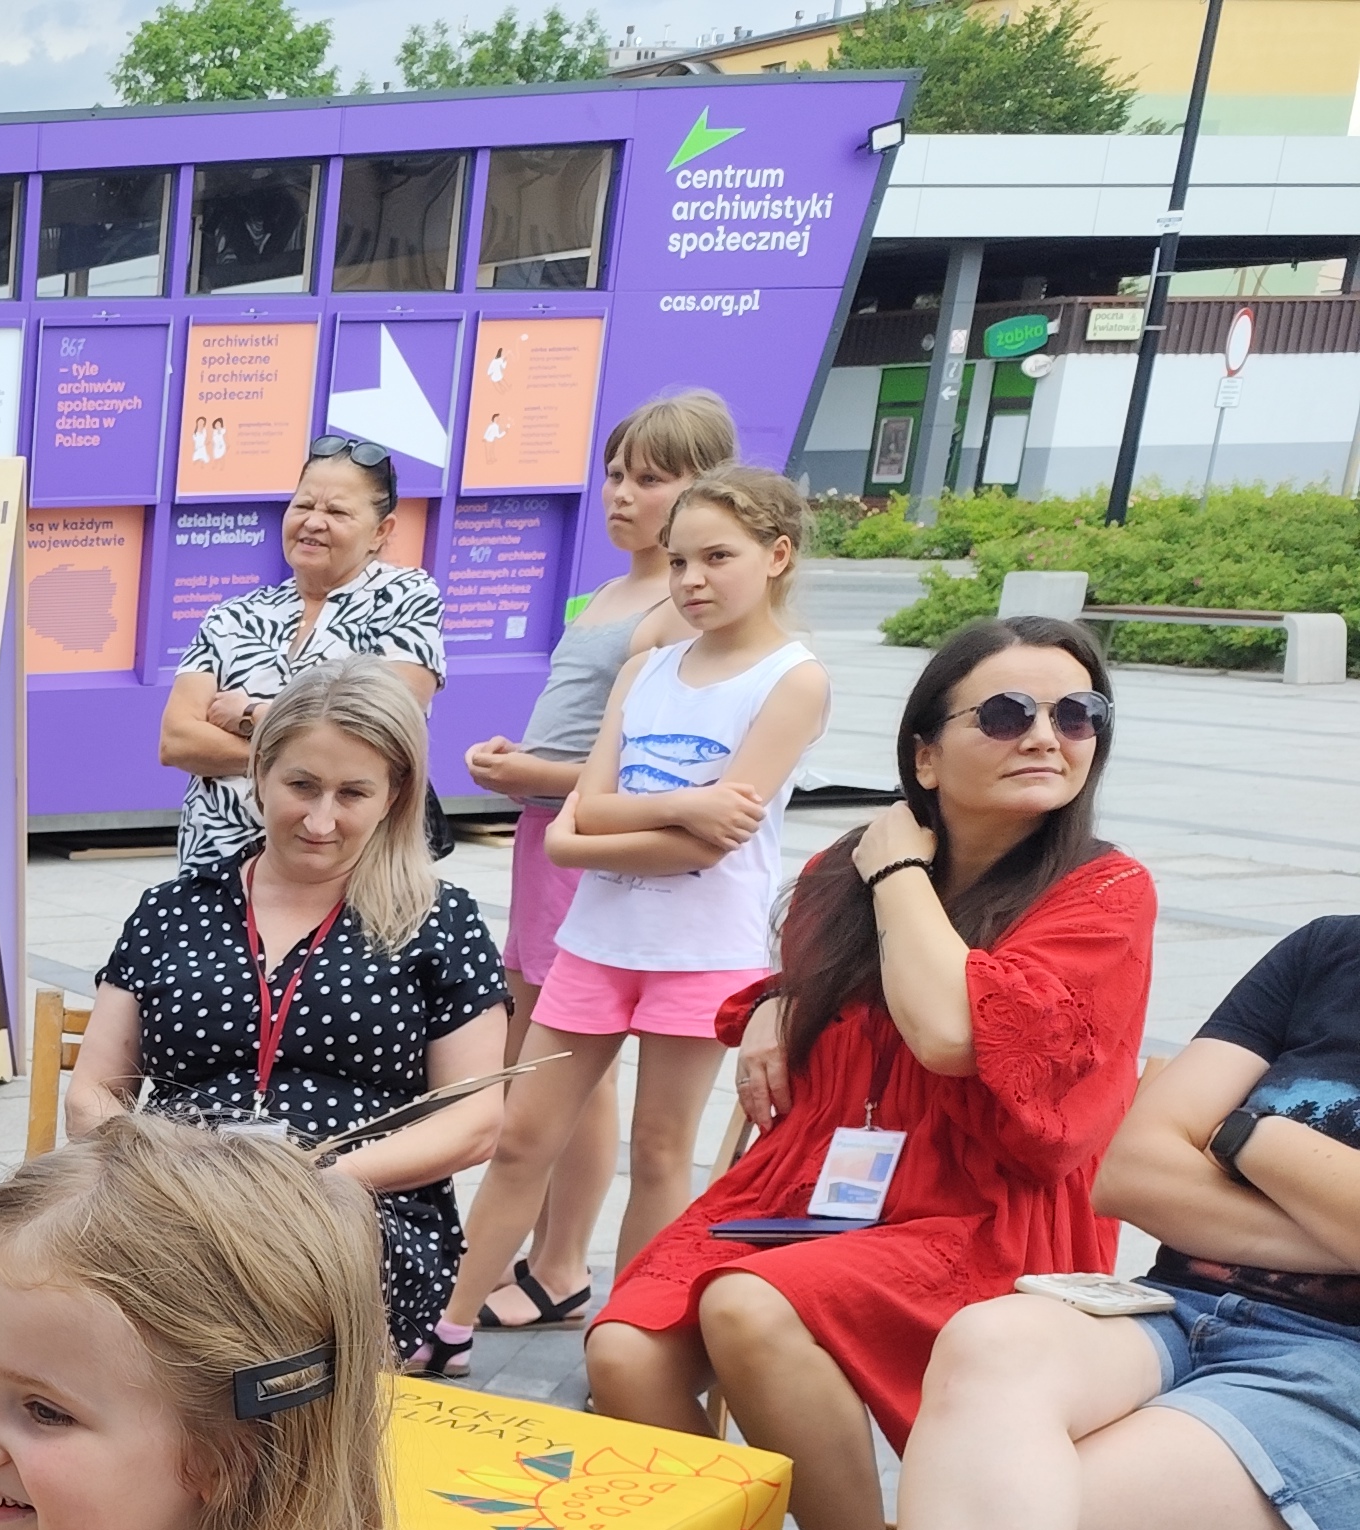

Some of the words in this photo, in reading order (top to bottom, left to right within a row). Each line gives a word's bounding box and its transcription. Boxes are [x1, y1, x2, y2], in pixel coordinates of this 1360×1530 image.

[676, 165, 784, 189] centrum
[672, 193, 833, 226] archiwistyki
[668, 225, 811, 259] społecznej
[660, 289, 760, 316] cas.org.pl
[203, 334, 279, 348] archiwistki
[201, 353, 270, 368] społeczne
[72, 361, 99, 380] tyle
[208, 370, 278, 383] archiwiści
[58, 379, 125, 394] archiwów
[199, 387, 264, 404] społeczni
[57, 396, 142, 416] społecznych
[56, 414, 99, 430] działa
[102, 417, 116, 428] w
[55, 433, 100, 447] Polsce
[456, 503, 488, 514] ponad
[29, 520, 44, 535] są
[48, 521, 60, 532] w
[63, 518, 113, 534] każdym
[177, 512, 234, 530] działają
[237, 511, 259, 527] też
[27, 536, 126, 552] województwie
[175, 532, 189, 546] w
[191, 530, 210, 548] tej
[212, 529, 265, 548] okolicy!
[395, 1391, 545, 1433] PACKIE
